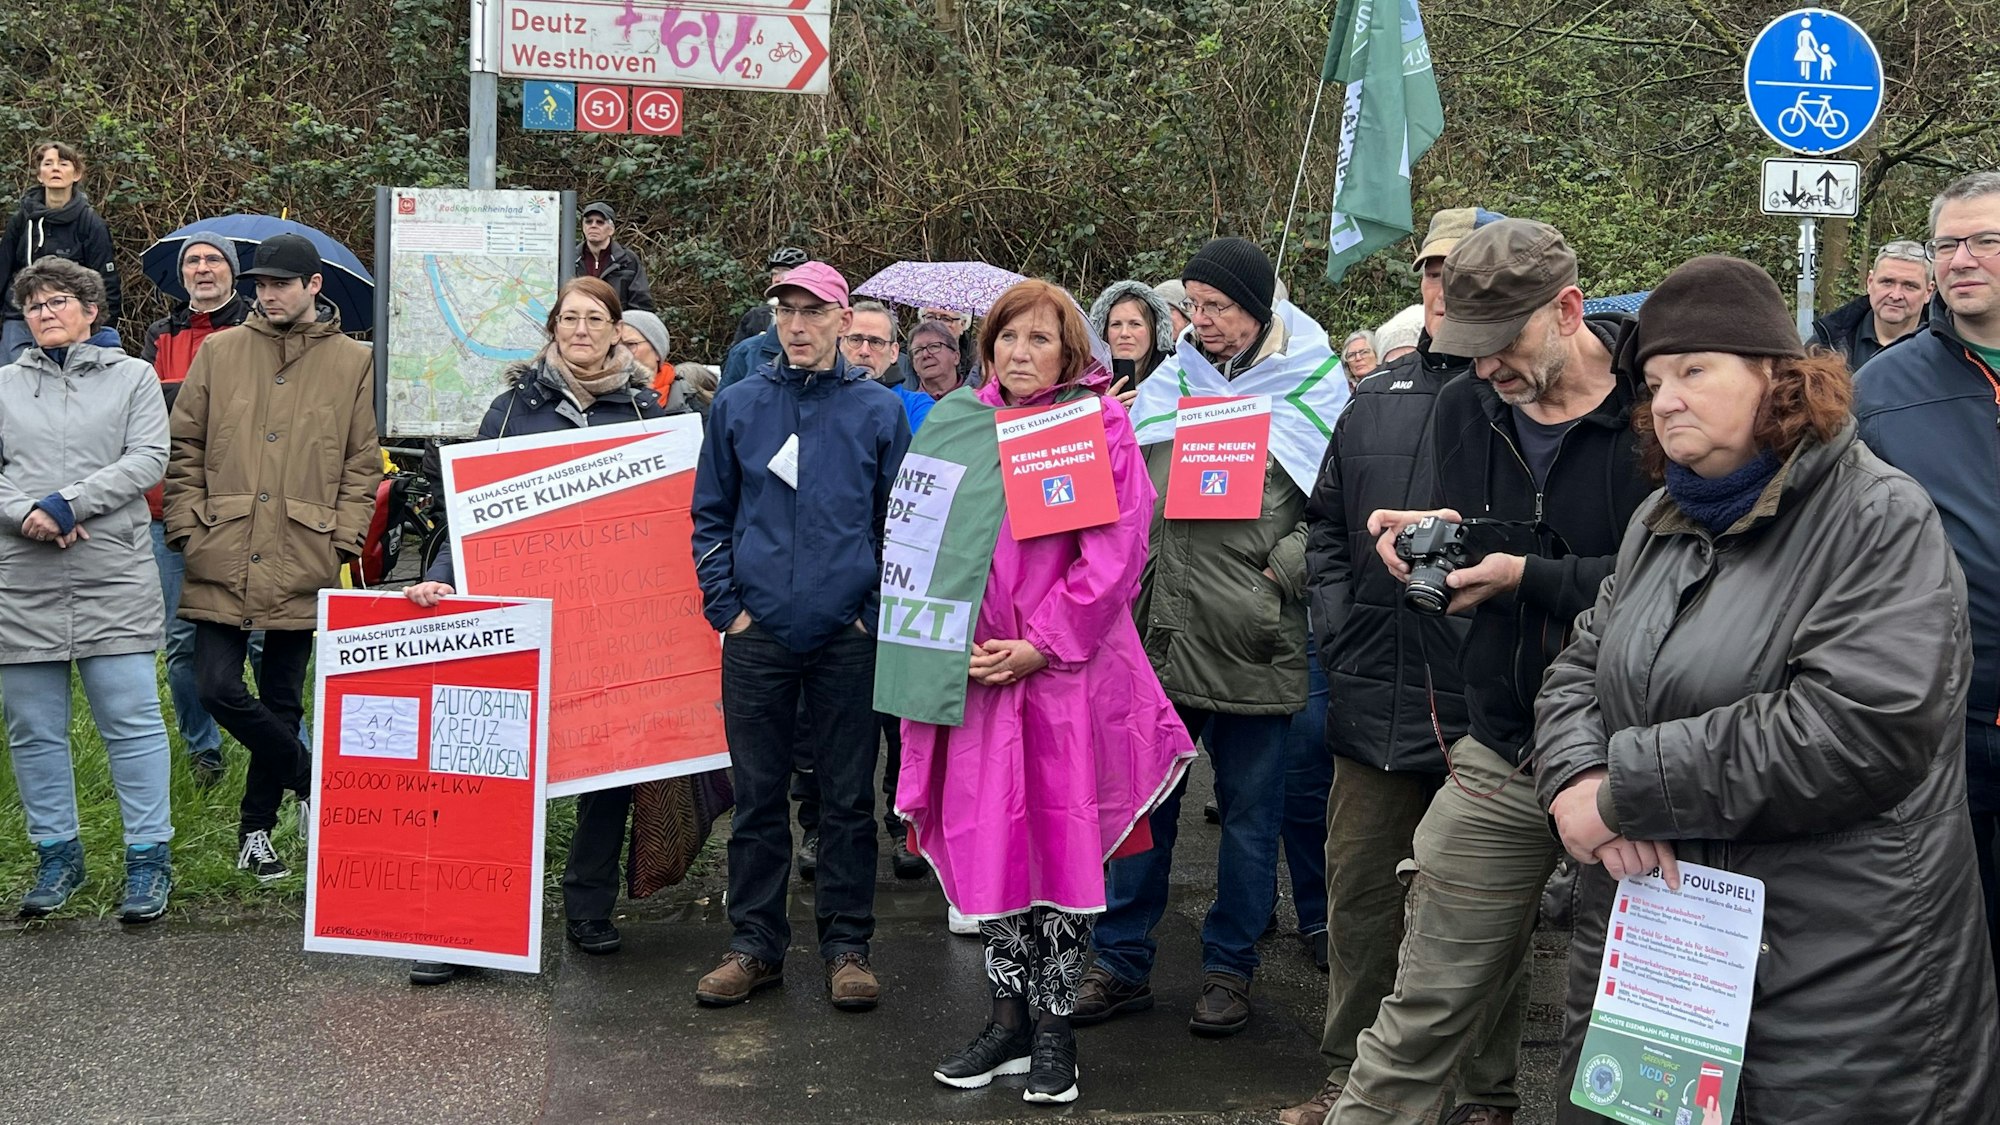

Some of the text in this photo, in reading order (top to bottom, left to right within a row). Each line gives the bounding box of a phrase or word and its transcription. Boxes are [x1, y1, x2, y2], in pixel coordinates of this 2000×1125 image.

[511, 8, 587, 34] Deutz
[748, 29, 764, 45] ,6
[512, 44, 656, 74] Westhoven
[741, 57, 763, 79] 2,9
[591, 101, 615, 117] 51
[643, 104, 671, 120] 45
[438, 203, 524, 214] RadRegionRheinland
[1390, 380, 1414, 390] JAKO
[1002, 406, 1084, 435] ROTE KLIMAKARTE
[1181, 403, 1257, 422] ROTE KLIMAKARTE
[1011, 440, 1094, 464] KEINE NEUEN
[1180, 454, 1254, 463] AUTOBAHNEN
[1182, 442, 1256, 452] KEINE NEUEN
[1012, 452, 1096, 476] AUTOBAHNEN
[468, 452, 624, 504] KLIMASCHUTZ AUSBREMSEN?
[472, 454, 667, 524] ROTE KLIMAKARTE
[476, 519, 650, 562] LEVERKUSEN
[521, 552, 597, 578] ERSTE
[337, 618, 480, 645] KLIMASCHUTZ AUSBREMSEN?
[606, 627, 681, 657] BRÜCKE
[340, 628, 516, 666] ROTE KLIMAKARTE
[566, 663, 632, 690] AUSBAU
[642, 654, 676, 678] AUF
[432, 688, 530, 720] AUTOBAHN
[367, 732, 376, 750] 3
[432, 716, 502, 746] KREUZ
[430, 744, 528, 778] LEVERKUSEN
[322, 807, 382, 828] JEDEN
[436, 865, 513, 893] NOCH?
[1683, 874, 1755, 902] FOULSPIEL!
[1670, 1033, 1680, 1042] DIE
[1584, 1058, 1600, 1088] PARENTS
[1606, 1059, 1621, 1082] FUTURE
[1640, 1064, 1663, 1082] VCD
[1589, 1089, 1617, 1104] GERMANY
